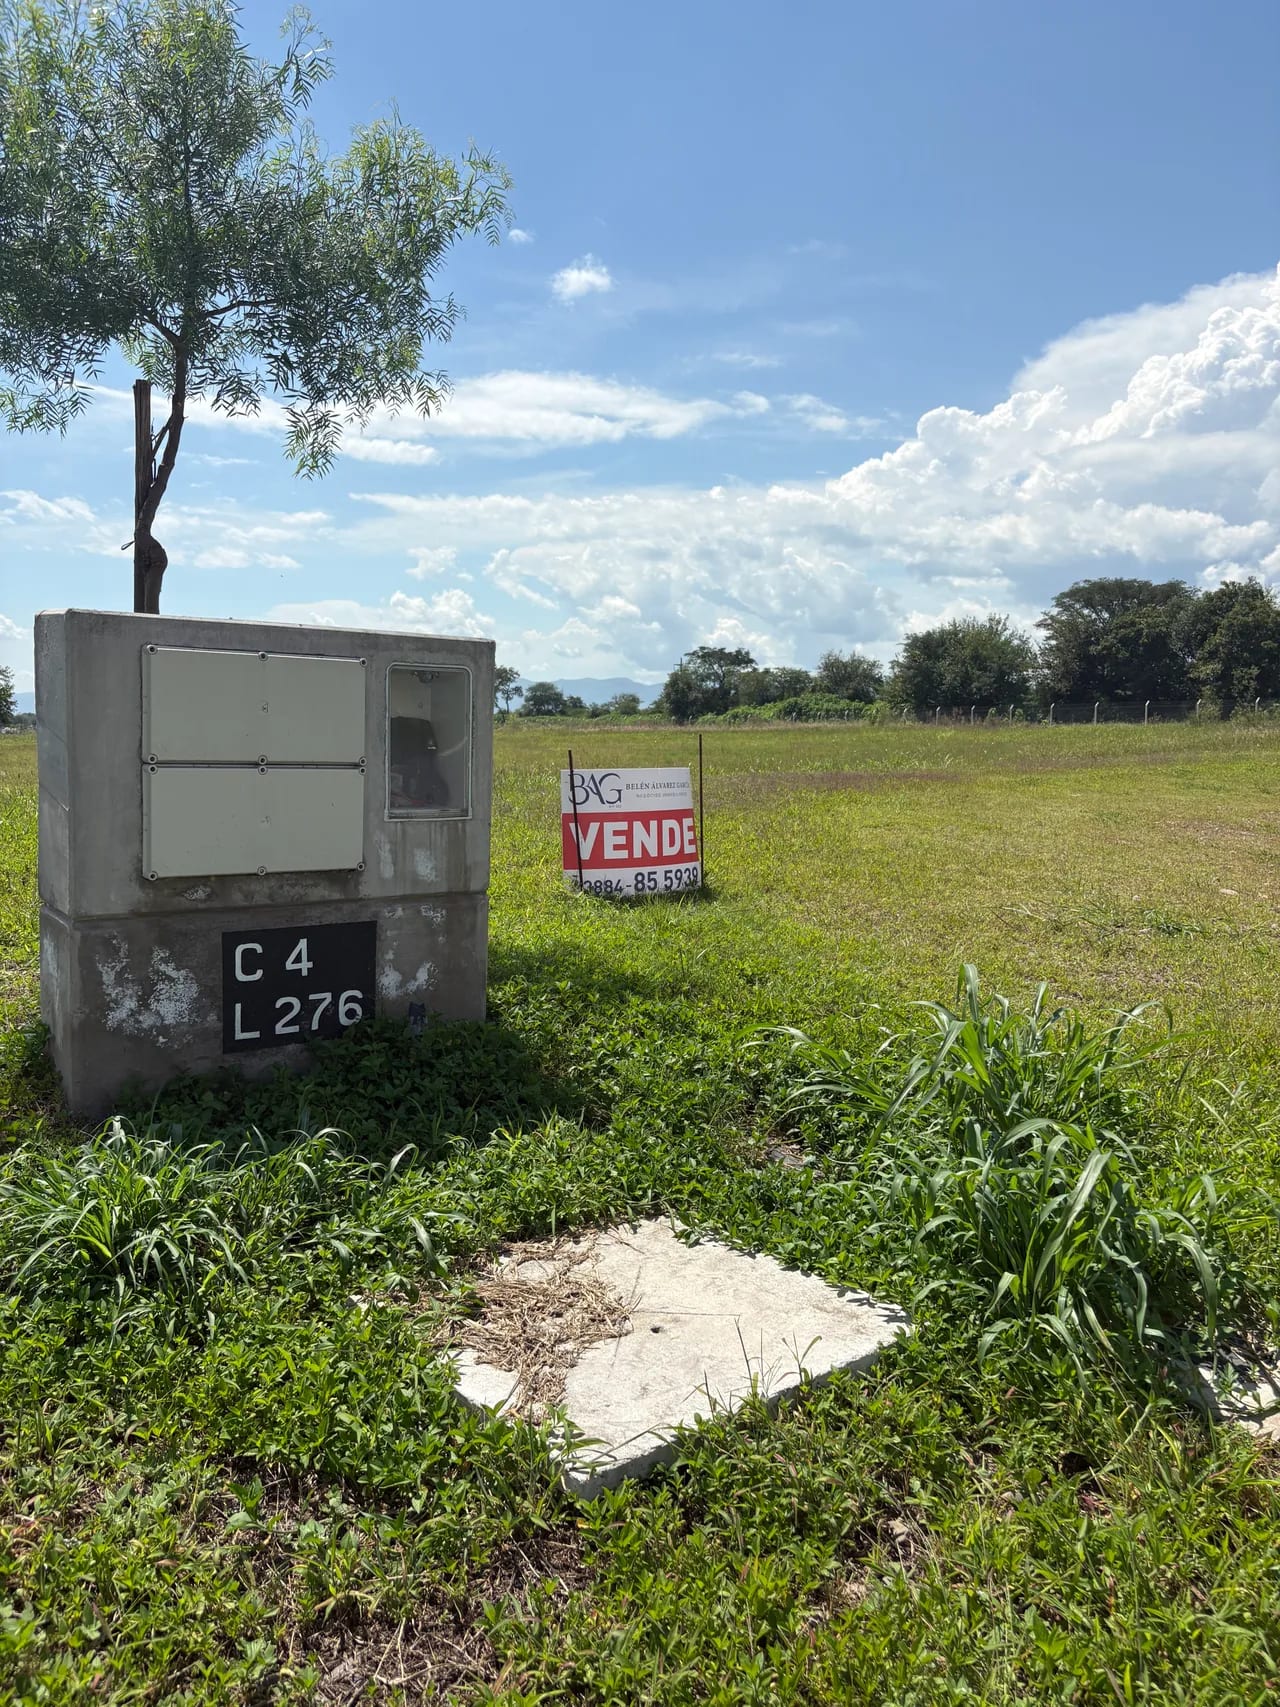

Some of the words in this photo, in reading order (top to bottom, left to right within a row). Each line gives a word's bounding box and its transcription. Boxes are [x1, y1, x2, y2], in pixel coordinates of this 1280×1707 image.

[568, 772, 623, 805] BAG
[625, 781, 650, 791] BELÉN
[569, 818, 697, 860] VENDE
[234, 943, 263, 982] C
[285, 938, 314, 976] 4
[234, 1002, 261, 1040] L
[274, 989, 363, 1035] 276
